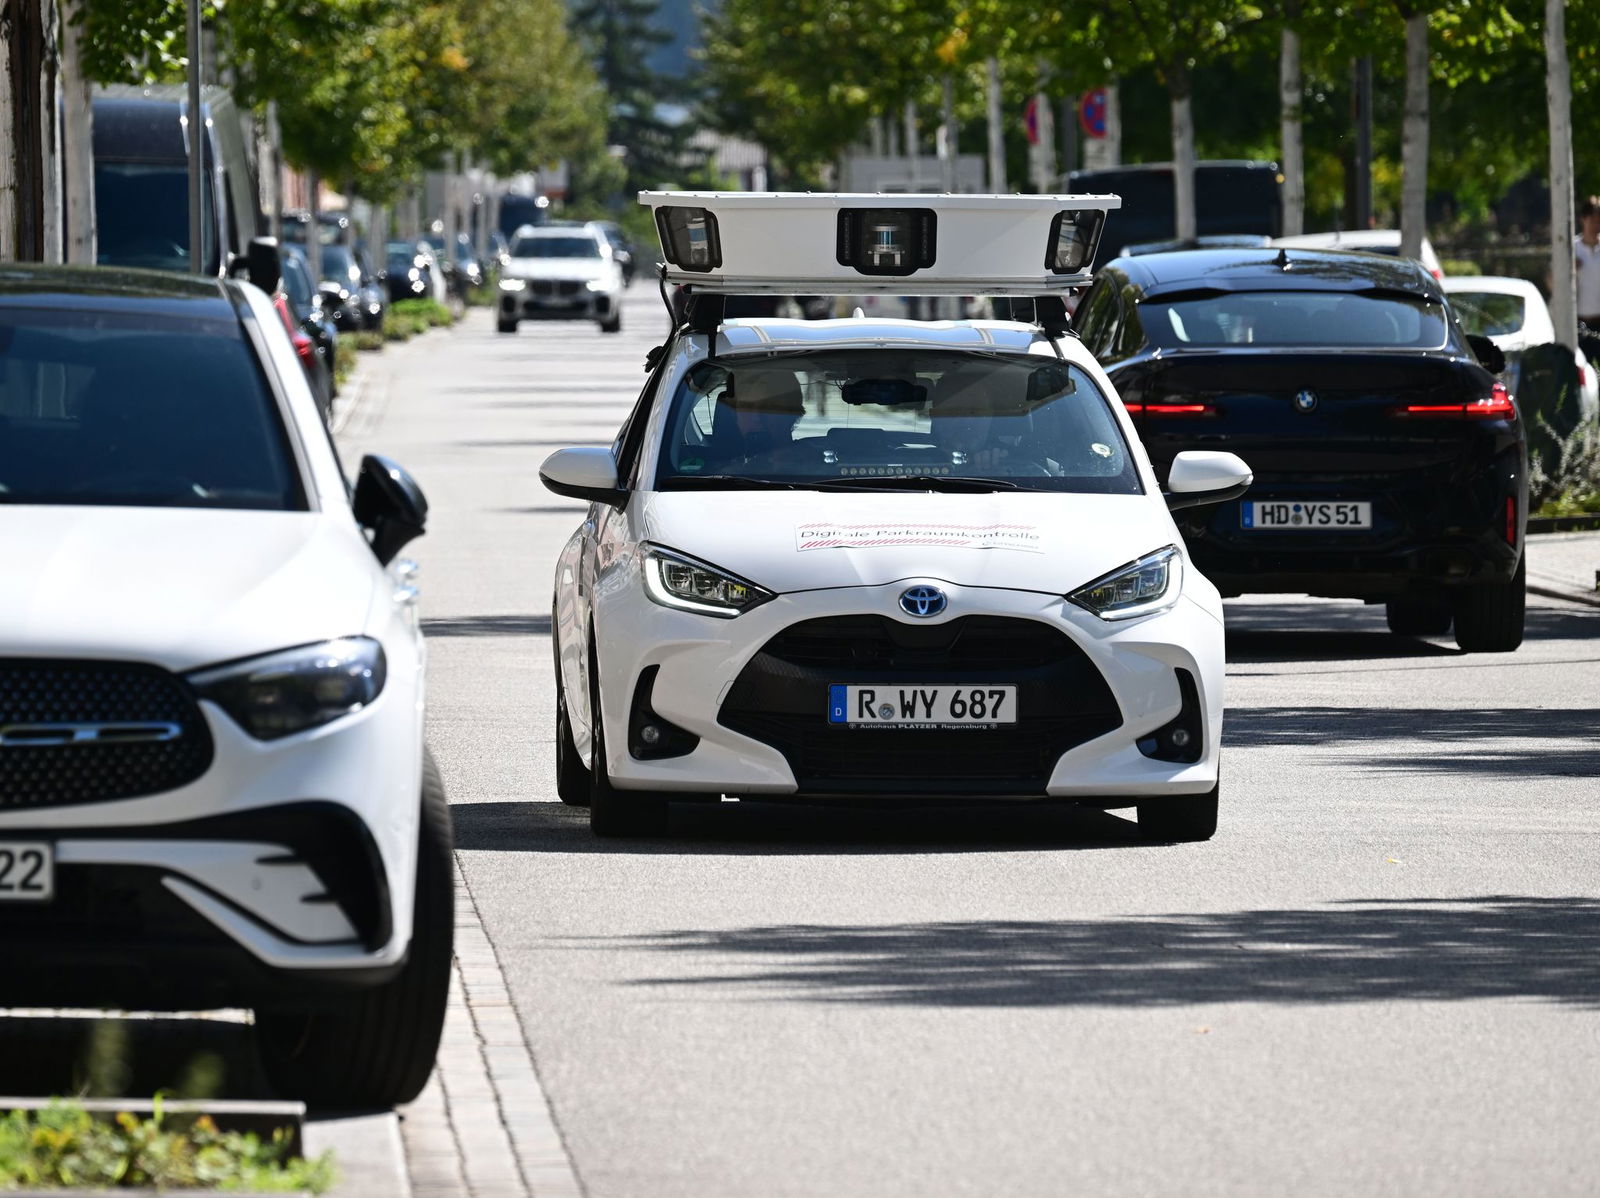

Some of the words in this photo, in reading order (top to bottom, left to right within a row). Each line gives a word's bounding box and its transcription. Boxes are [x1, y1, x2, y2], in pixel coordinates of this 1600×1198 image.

[1261, 504, 1289, 525] HD
[1304, 504, 1331, 525] YS
[1335, 504, 1362, 525] 51
[876, 530, 1040, 540] Parkraumkontrolle
[835, 707, 842, 716] D
[858, 689, 877, 719] R
[899, 689, 938, 719] WY
[949, 689, 1006, 719] 687
[0, 849, 44, 892] 22
